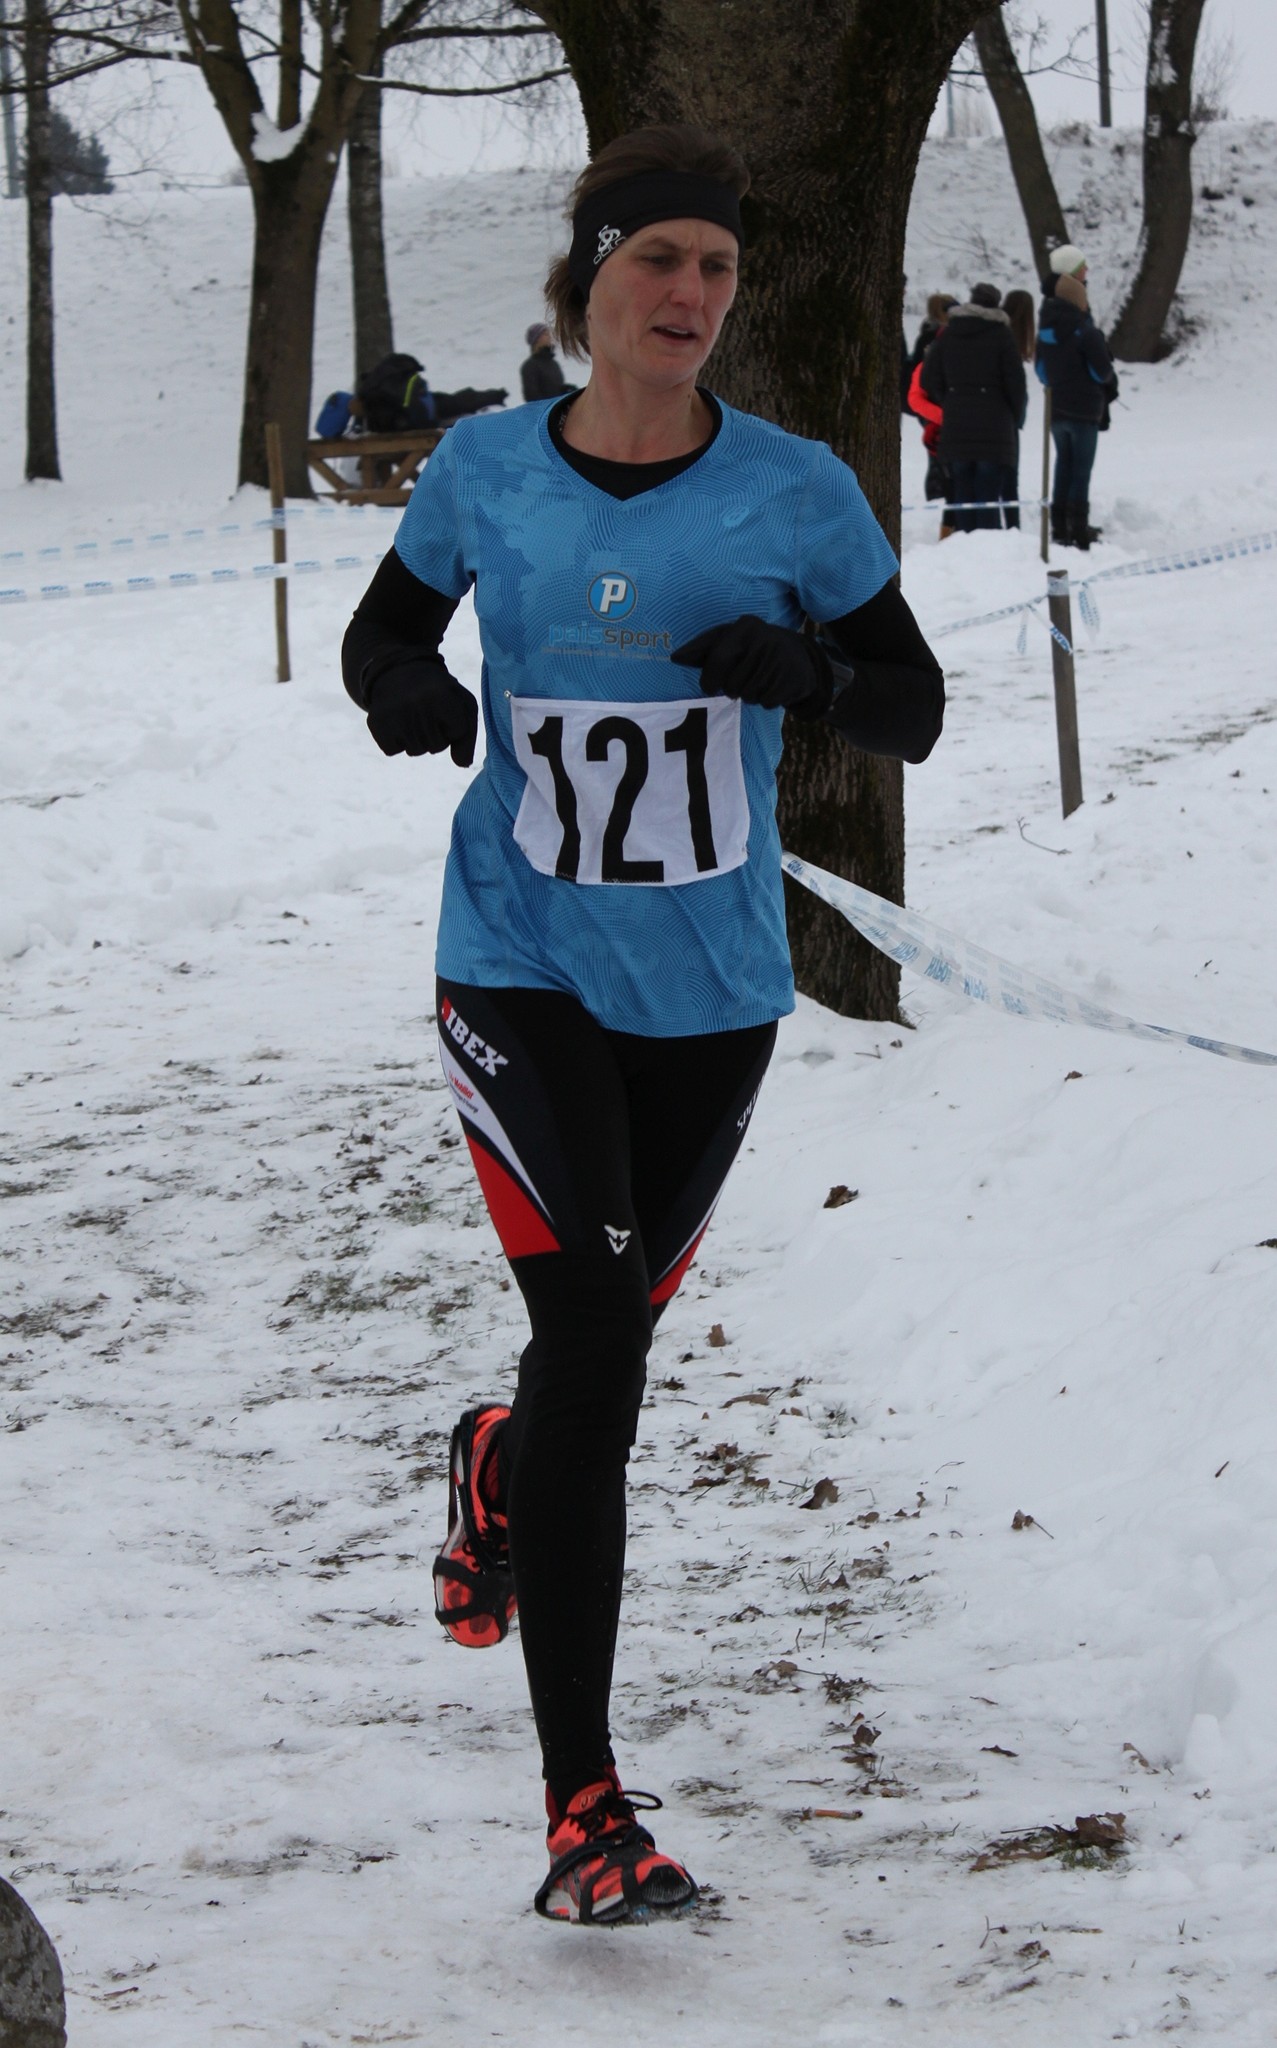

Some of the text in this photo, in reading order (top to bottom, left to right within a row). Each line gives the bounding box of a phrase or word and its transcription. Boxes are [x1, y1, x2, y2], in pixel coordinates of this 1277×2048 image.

[599, 577, 627, 615] P
[527, 707, 718, 883] 121
[445, 1007, 509, 1077] IBEX
